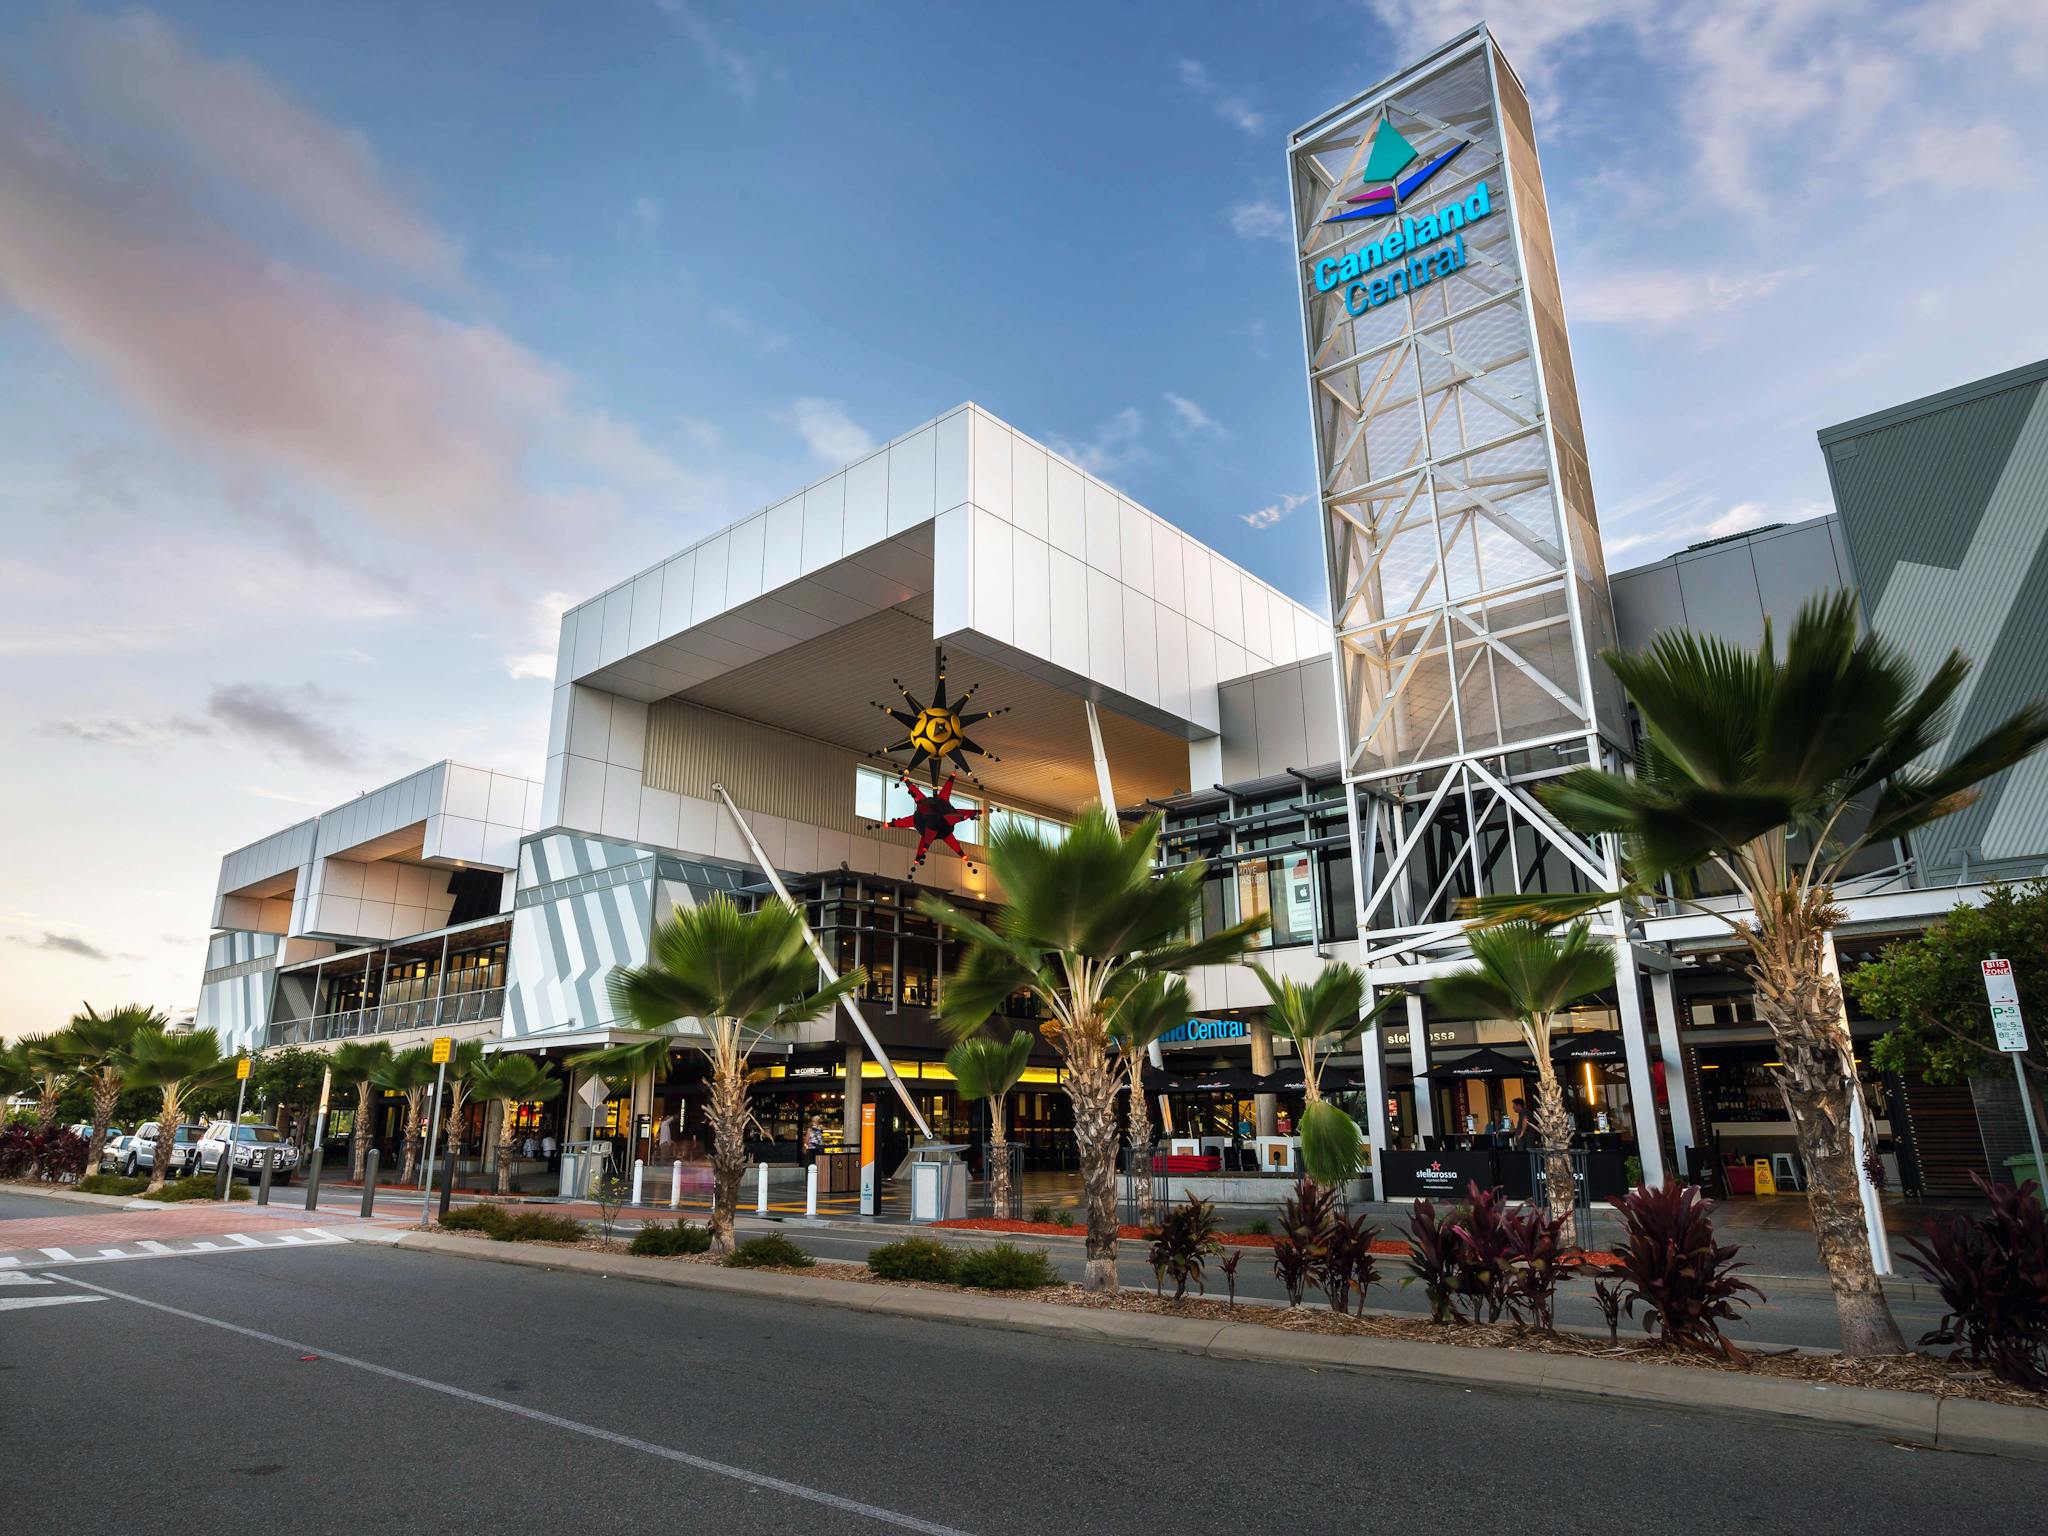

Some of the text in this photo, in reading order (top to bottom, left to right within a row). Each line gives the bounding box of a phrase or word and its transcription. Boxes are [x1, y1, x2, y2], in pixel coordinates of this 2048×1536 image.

[1314, 181, 1492, 293] Caneland
[1345, 233, 1468, 317] Central
[1985, 968, 2010, 976] ZONE
[1992, 1007, 2004, 1018] P
[1187, 1019, 1244, 1041] Central
[1416, 1168, 1458, 1179] stellarossa
